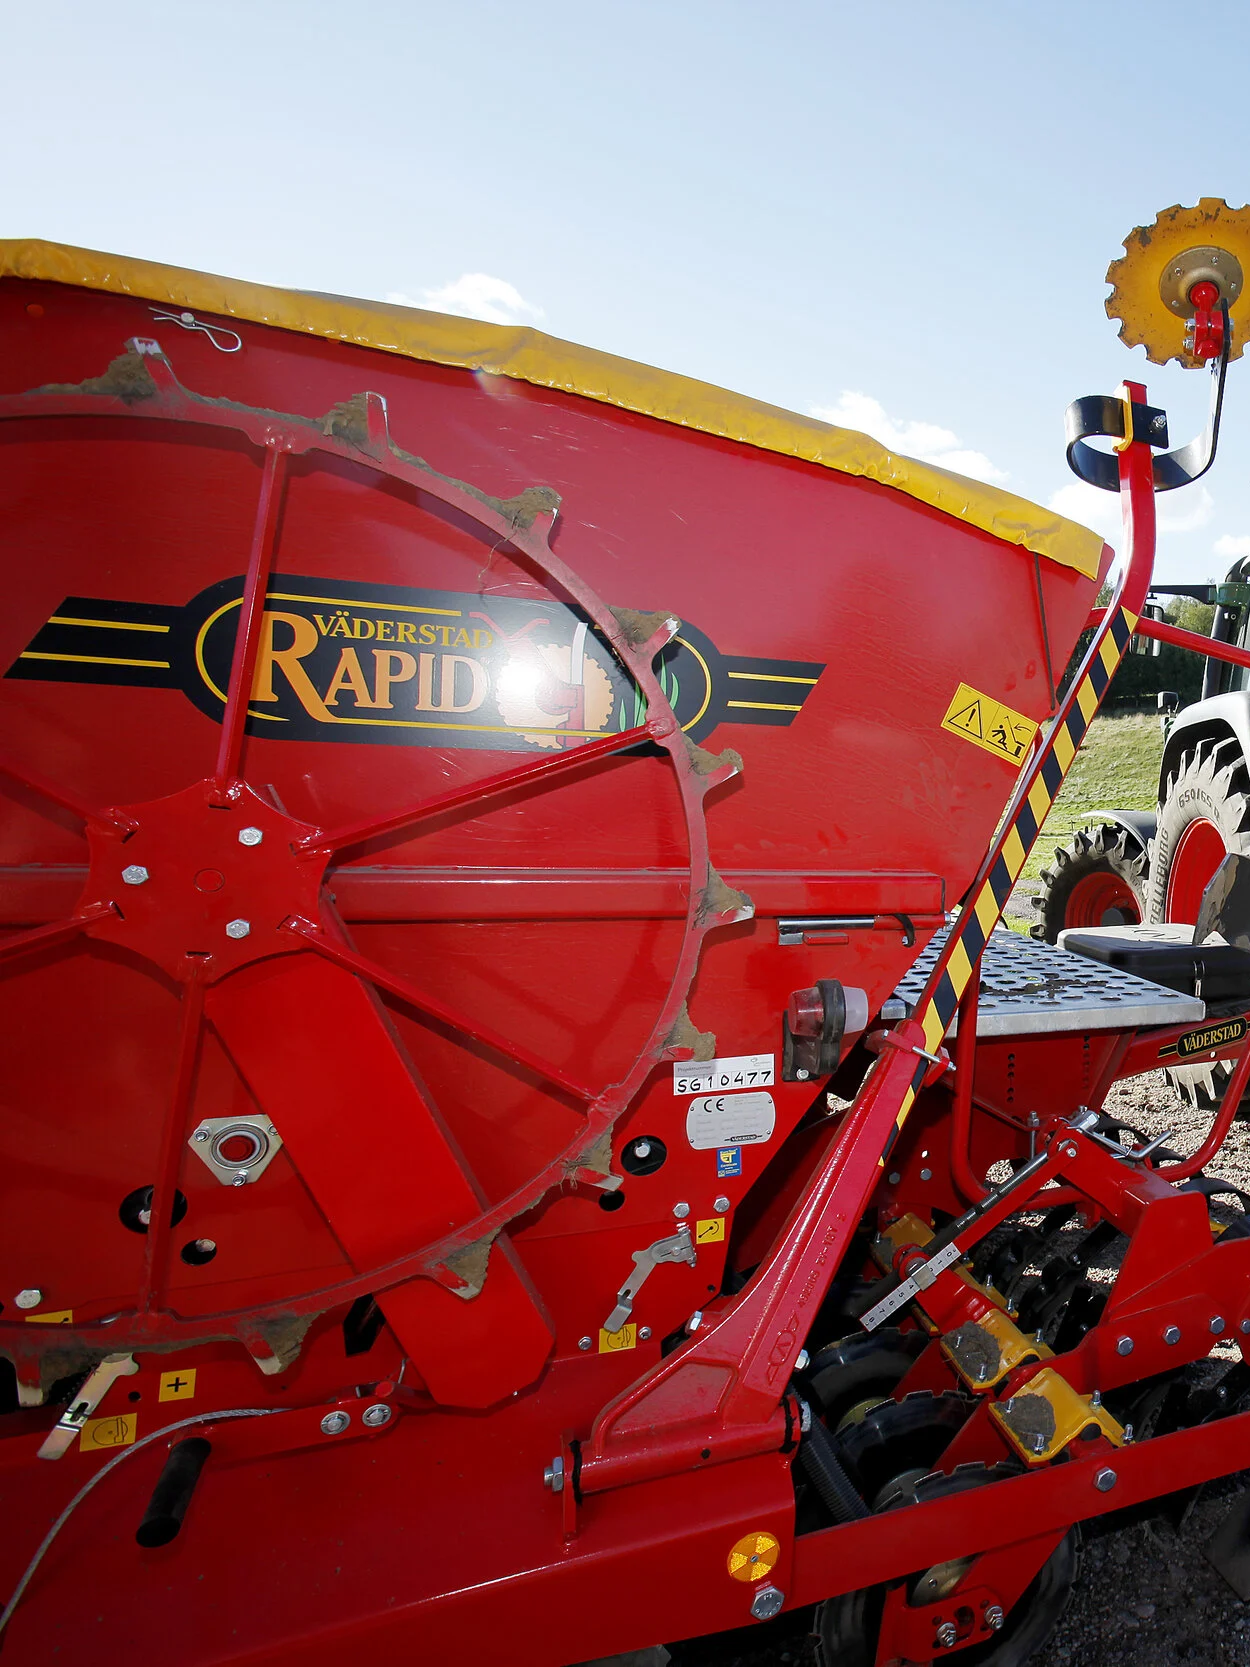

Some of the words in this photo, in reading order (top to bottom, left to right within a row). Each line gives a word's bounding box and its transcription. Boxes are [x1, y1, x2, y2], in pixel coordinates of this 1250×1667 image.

[312, 610, 493, 649] VÄDERSTAD
[249, 610, 488, 723] RAPID
[1149, 828, 1169, 924] RELLEBORG
[1183, 1023, 1241, 1052] VÄDERSTAD
[677, 1070, 772, 1093] SG10477
[703, 1098, 725, 1113] CE
